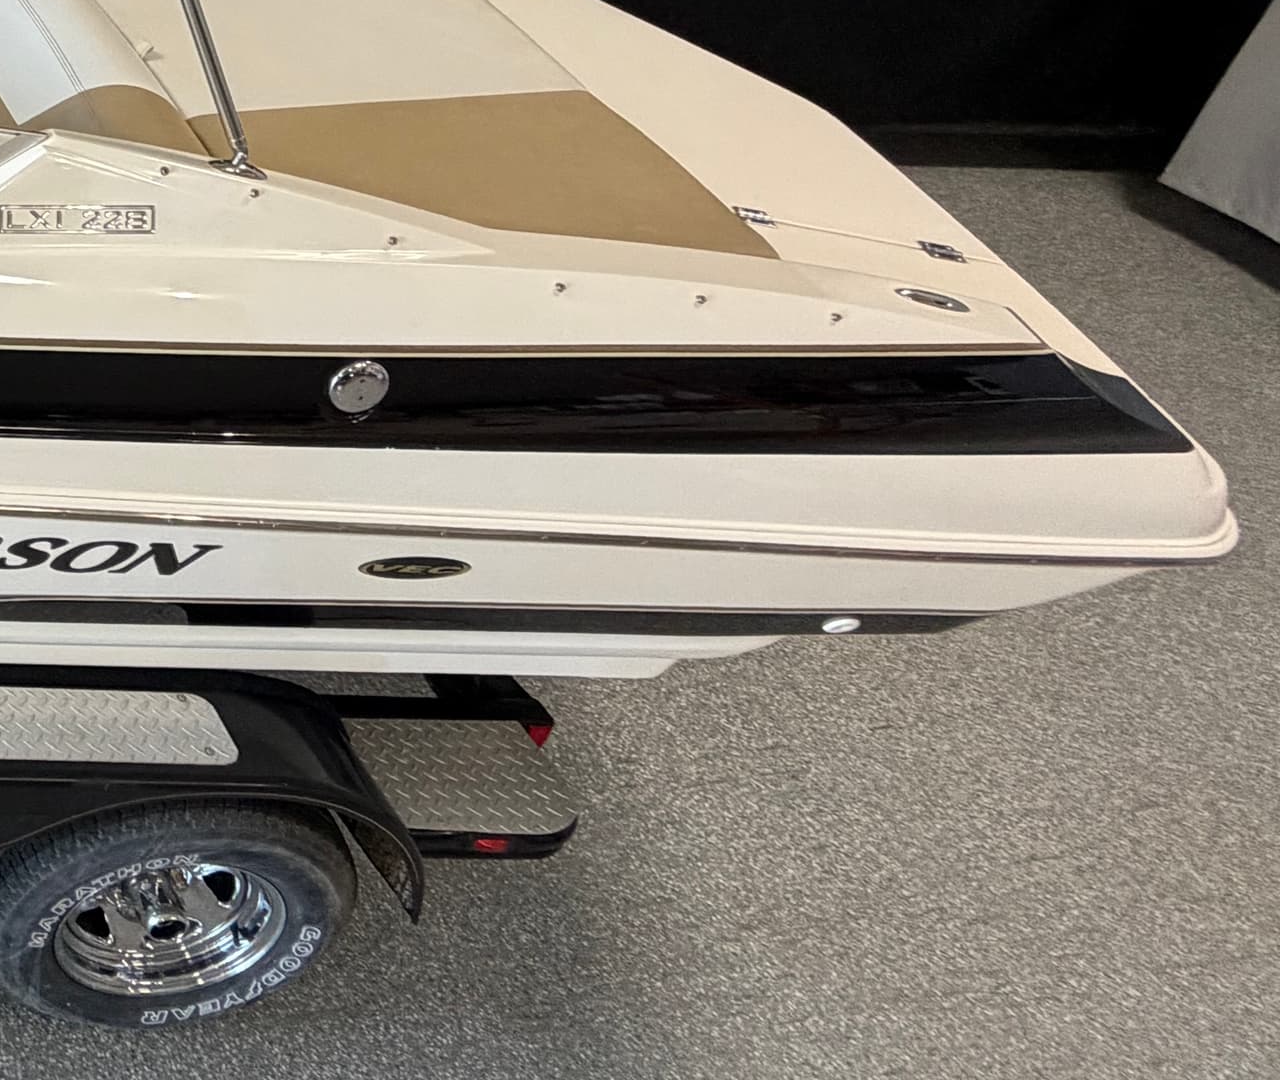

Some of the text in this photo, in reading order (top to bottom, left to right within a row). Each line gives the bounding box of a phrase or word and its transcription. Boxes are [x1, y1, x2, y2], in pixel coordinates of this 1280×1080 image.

[81, 210, 148, 229] 228
[28, 855, 199, 948] MARATHON
[141, 925, 321, 1025] GOODYEAR
